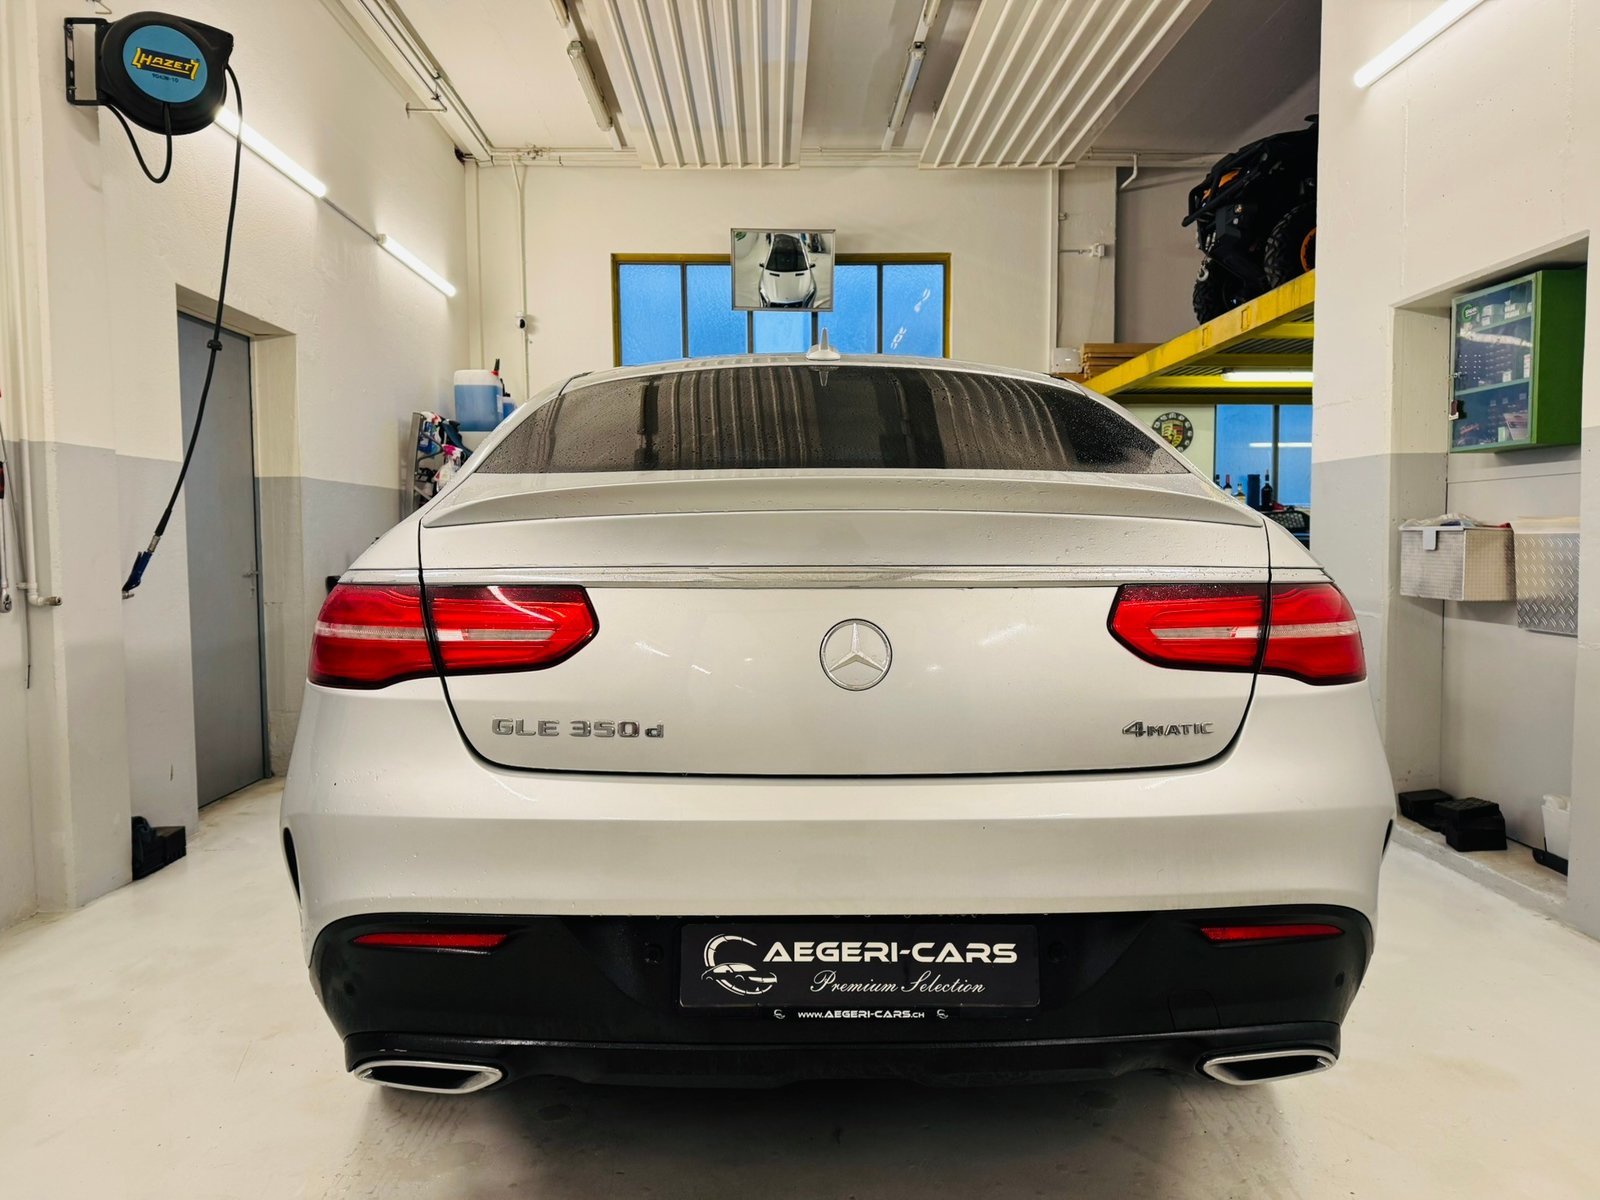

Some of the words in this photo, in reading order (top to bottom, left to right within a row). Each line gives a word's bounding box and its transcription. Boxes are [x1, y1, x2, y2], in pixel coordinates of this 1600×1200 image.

[139, 53, 193, 71] HAZET
[491, 717, 560, 737] GLE
[1122, 720, 1214, 738] 4MATIC
[762, 941, 1018, 964] AEGERI-CARS
[810, 969, 899, 993] Premium
[900, 970, 986, 993] Selection
